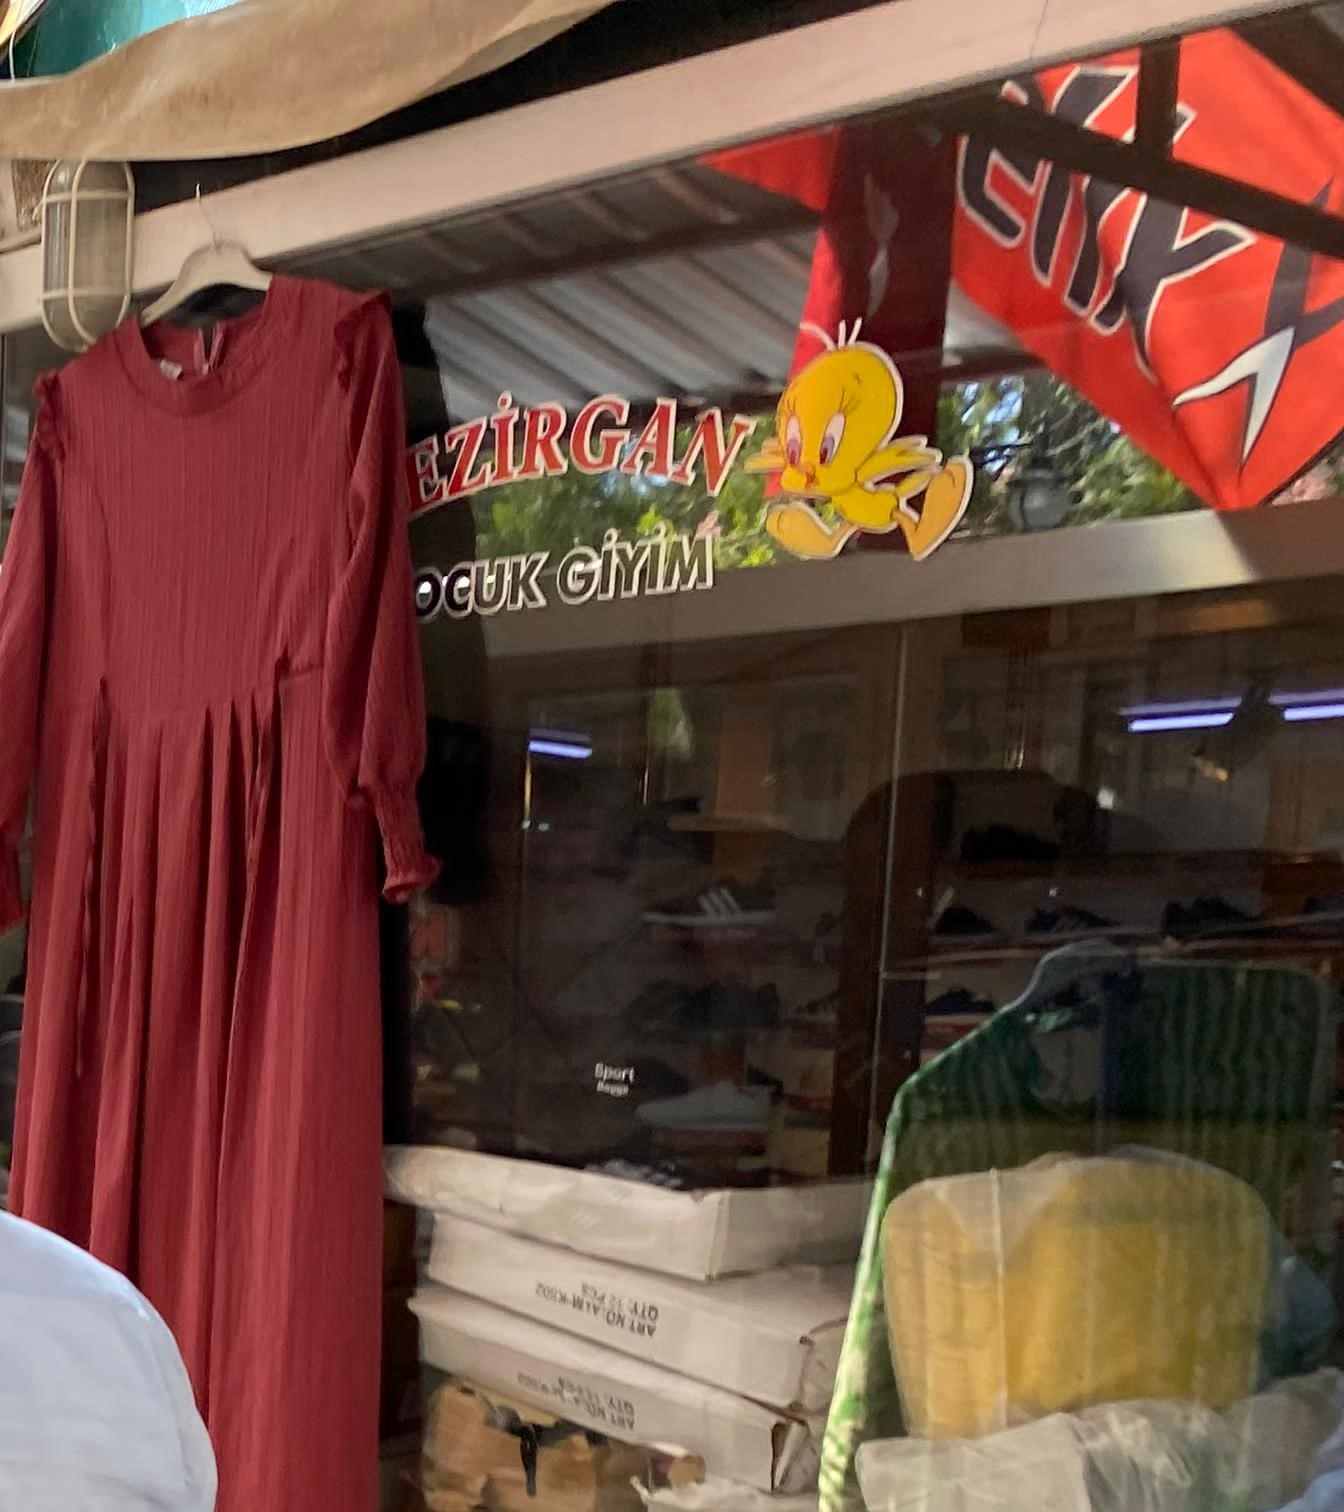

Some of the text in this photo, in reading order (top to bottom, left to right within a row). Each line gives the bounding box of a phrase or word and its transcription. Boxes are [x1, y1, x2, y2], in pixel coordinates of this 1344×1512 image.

[409, 391, 754, 512] EZİRGAN
[414, 526, 716, 621] OCUK GİYİM
